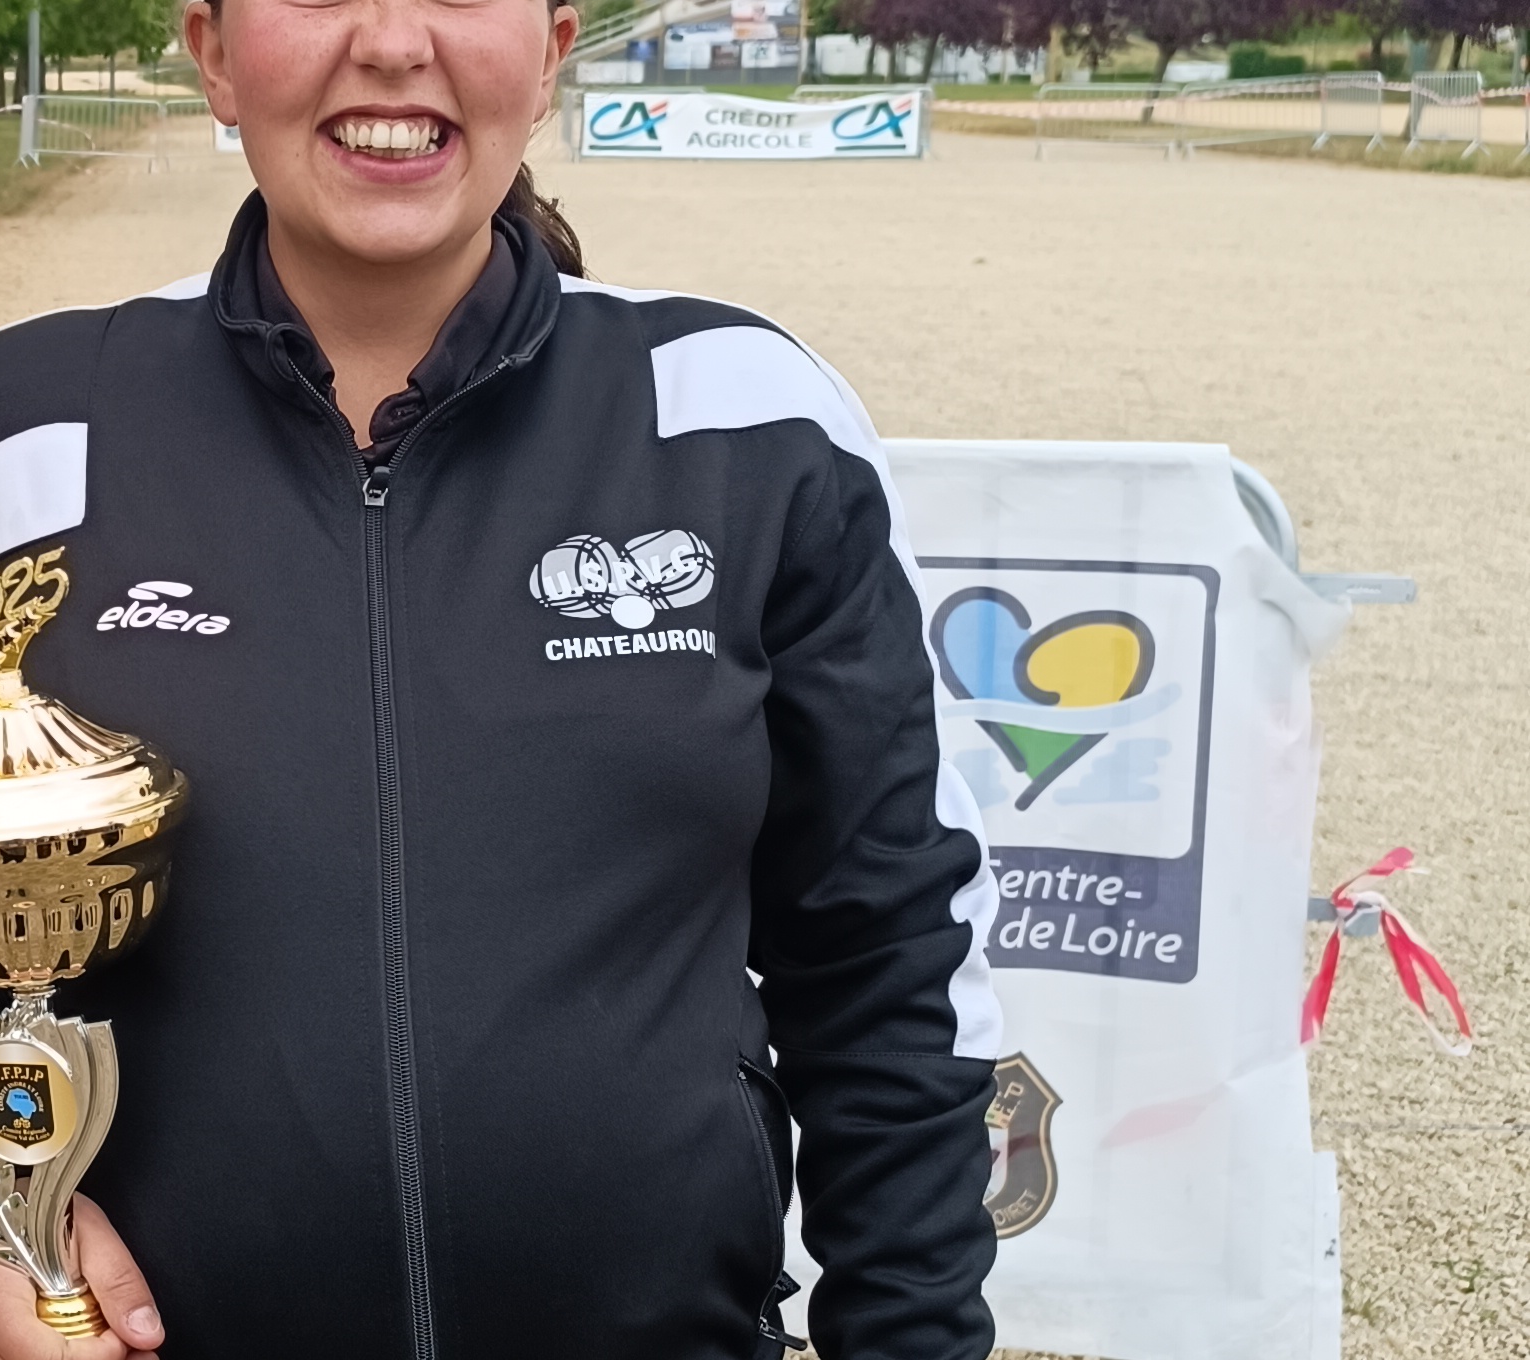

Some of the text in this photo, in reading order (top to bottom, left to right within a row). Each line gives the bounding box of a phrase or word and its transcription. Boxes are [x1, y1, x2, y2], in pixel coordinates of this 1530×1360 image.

[705, 107, 798, 128] CRÉDIT
[686, 132, 813, 149] AGRICOLE
[96, 600, 230, 635] eldera
[545, 628, 716, 660] CHATEAUROU
[989, 859, 1142, 906] entre-
[1061, 912, 1183, 963] Loire
[994, 1188, 1039, 1227] OIRET
